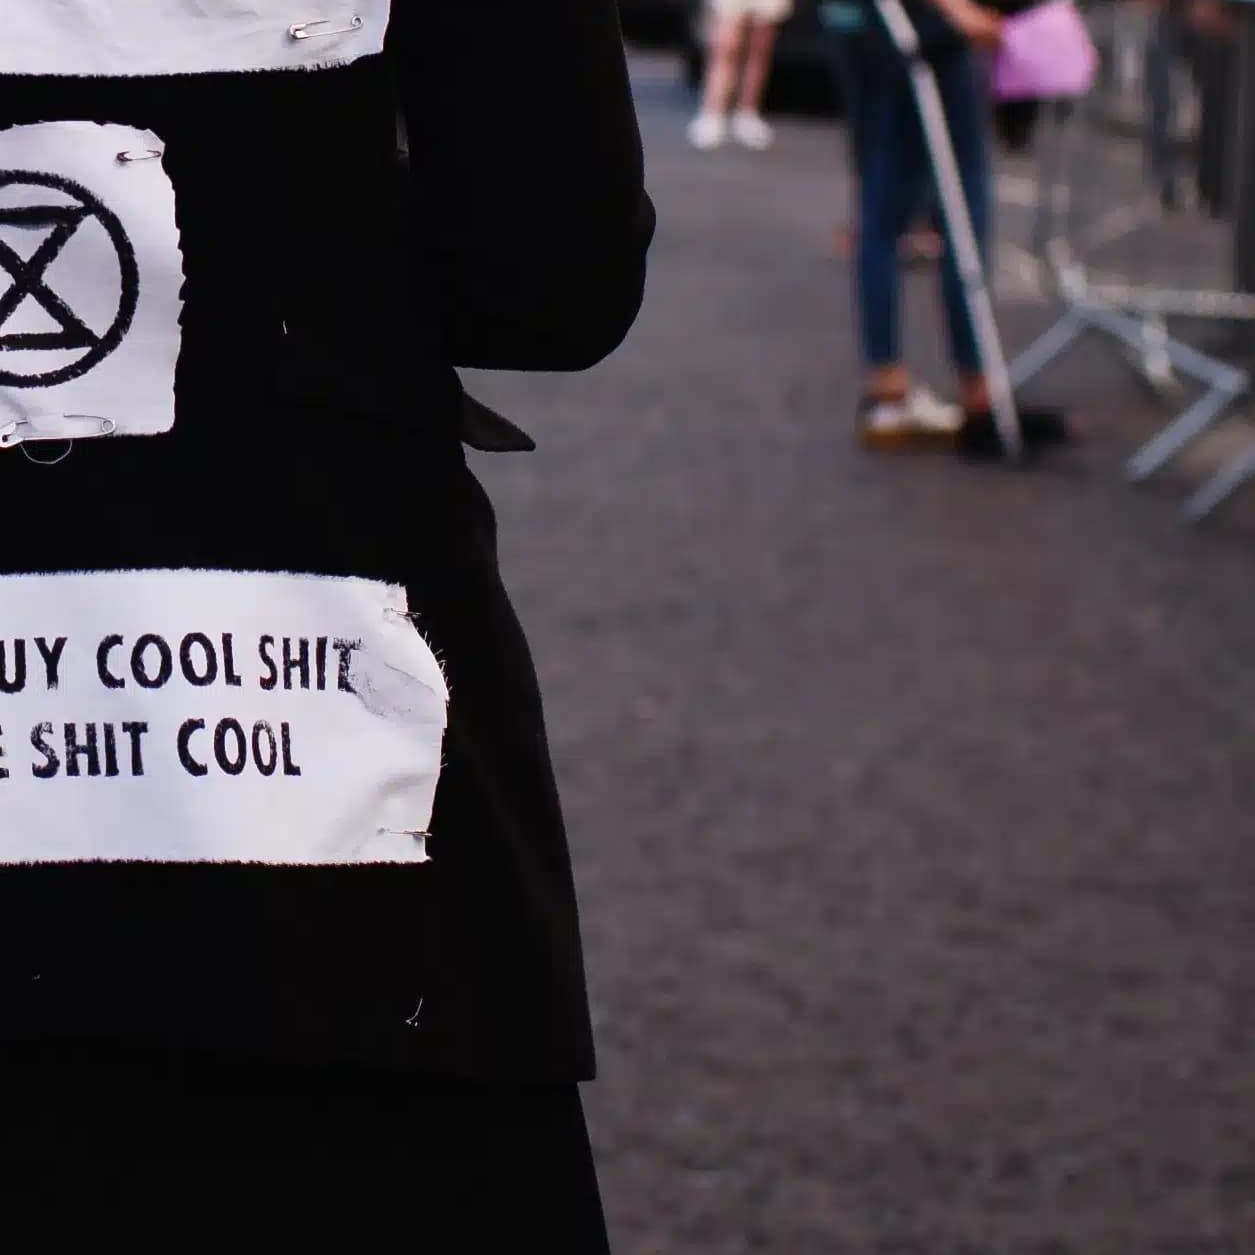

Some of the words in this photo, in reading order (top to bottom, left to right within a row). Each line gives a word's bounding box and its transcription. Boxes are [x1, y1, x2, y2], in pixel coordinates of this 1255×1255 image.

[96, 632, 242, 690] COOL
[258, 634, 363, 695] SHIT
[30, 720, 149, 779] SHIT
[176, 717, 302, 777] COOL
